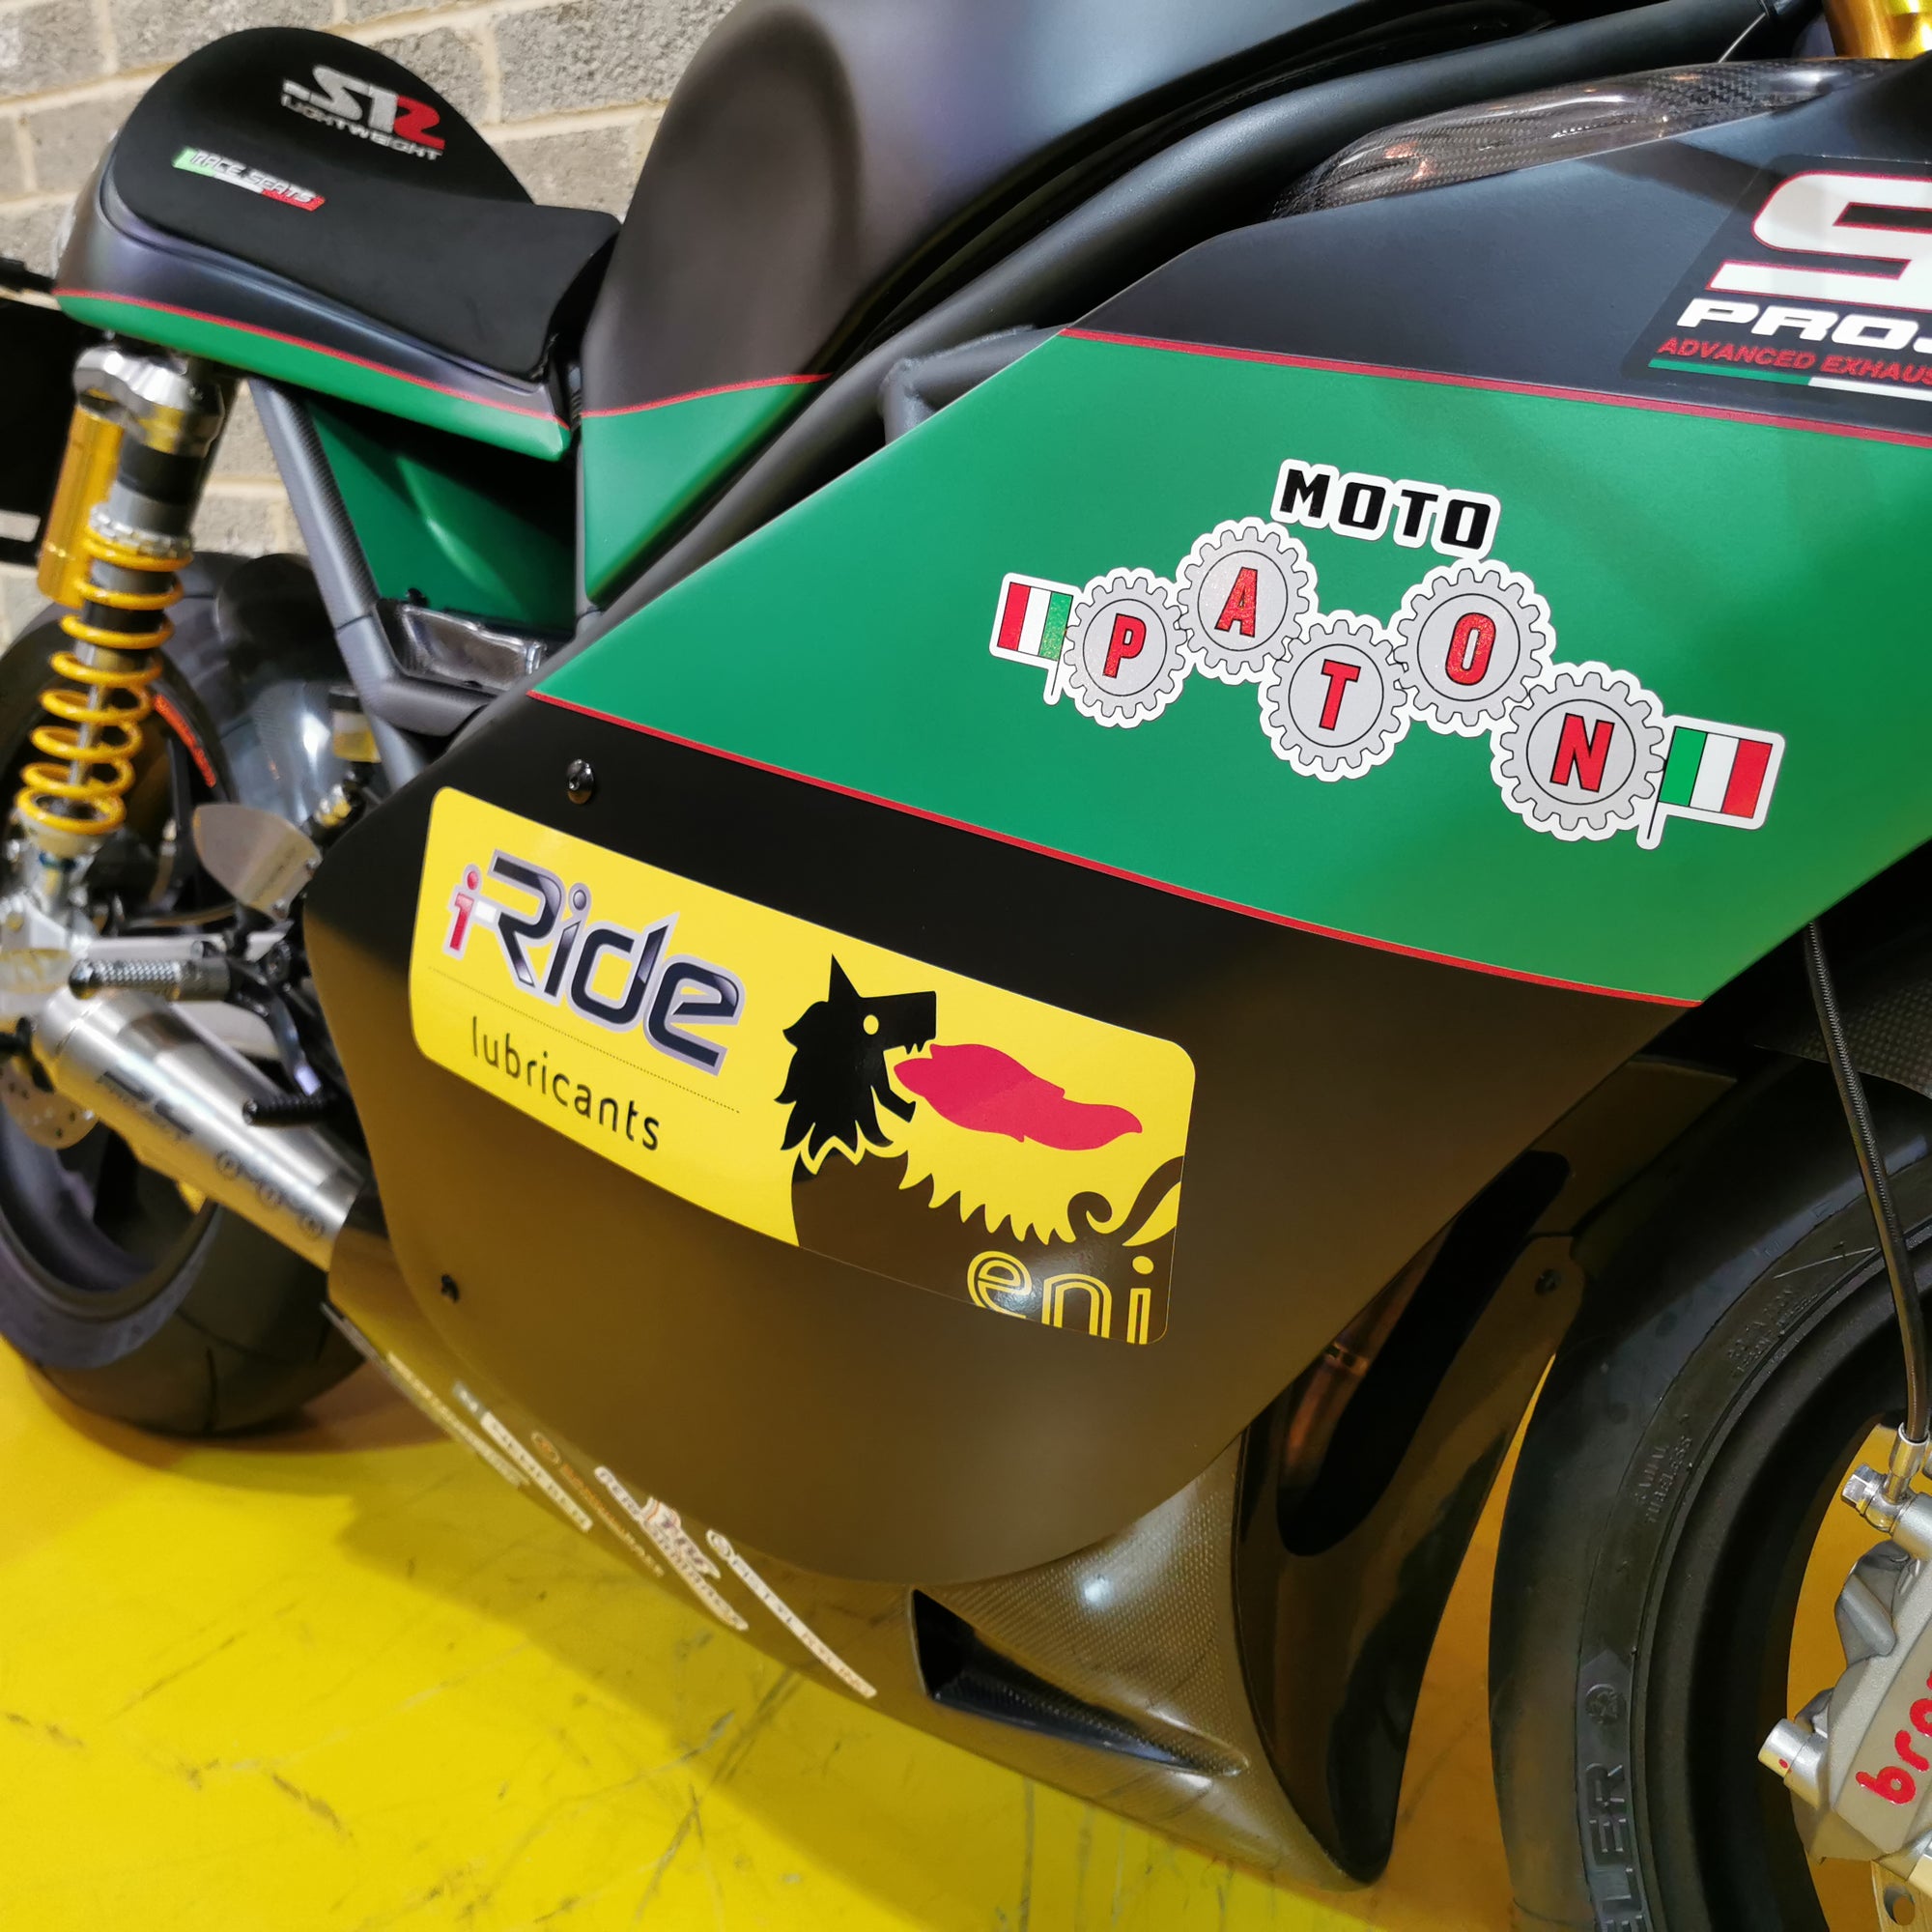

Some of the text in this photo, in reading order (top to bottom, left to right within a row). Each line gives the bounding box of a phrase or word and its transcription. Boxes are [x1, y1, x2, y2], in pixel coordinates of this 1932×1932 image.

[191, 149, 317, 204] RACE SEATS
[1656, 336, 1817, 370] ADVANCED
[1281, 469, 1495, 551] MOTO
[471, 1015, 661, 1151] lubricants
[967, 1250, 1154, 1345] eni
